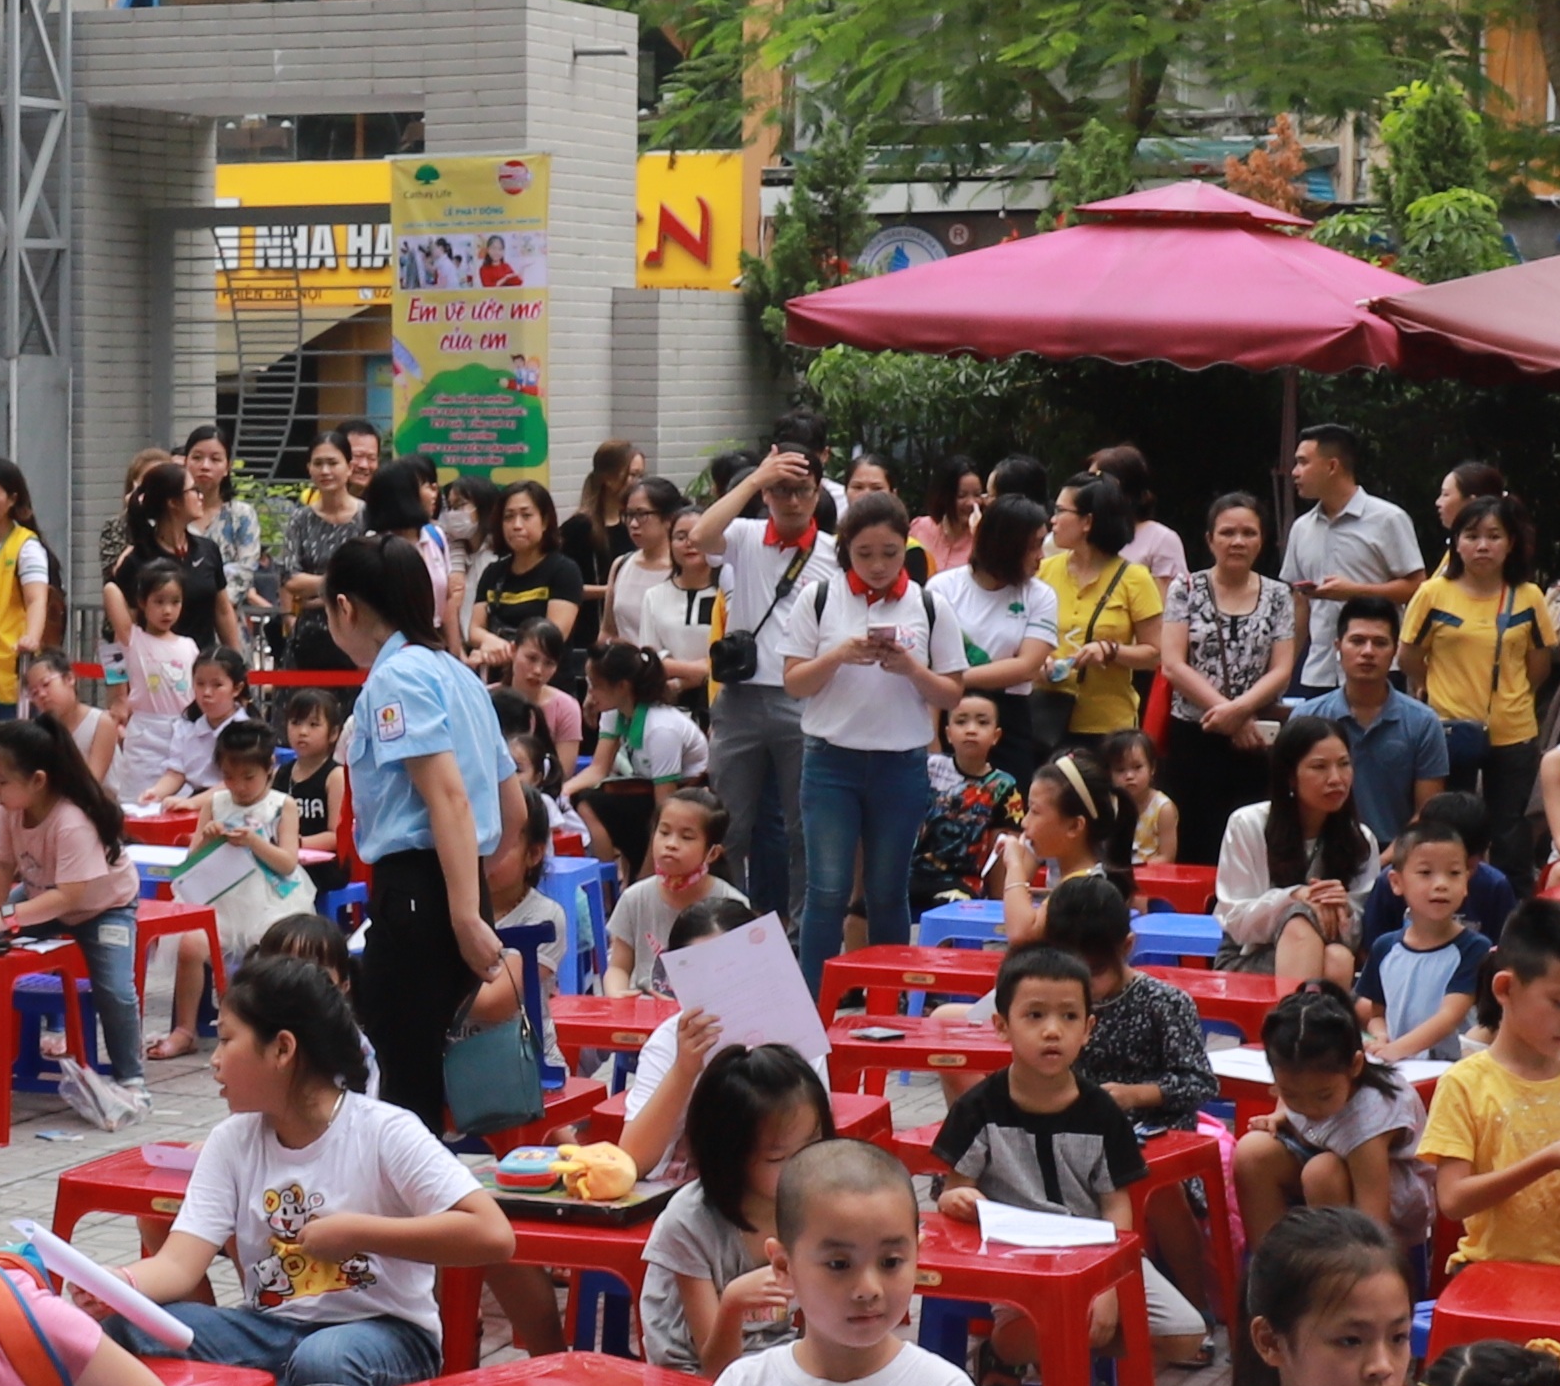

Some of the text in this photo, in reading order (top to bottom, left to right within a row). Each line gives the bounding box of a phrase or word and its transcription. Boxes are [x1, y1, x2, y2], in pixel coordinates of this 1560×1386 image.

[407, 297, 544, 323] Em vẽ ước mơ
[439, 327, 509, 351] của em
